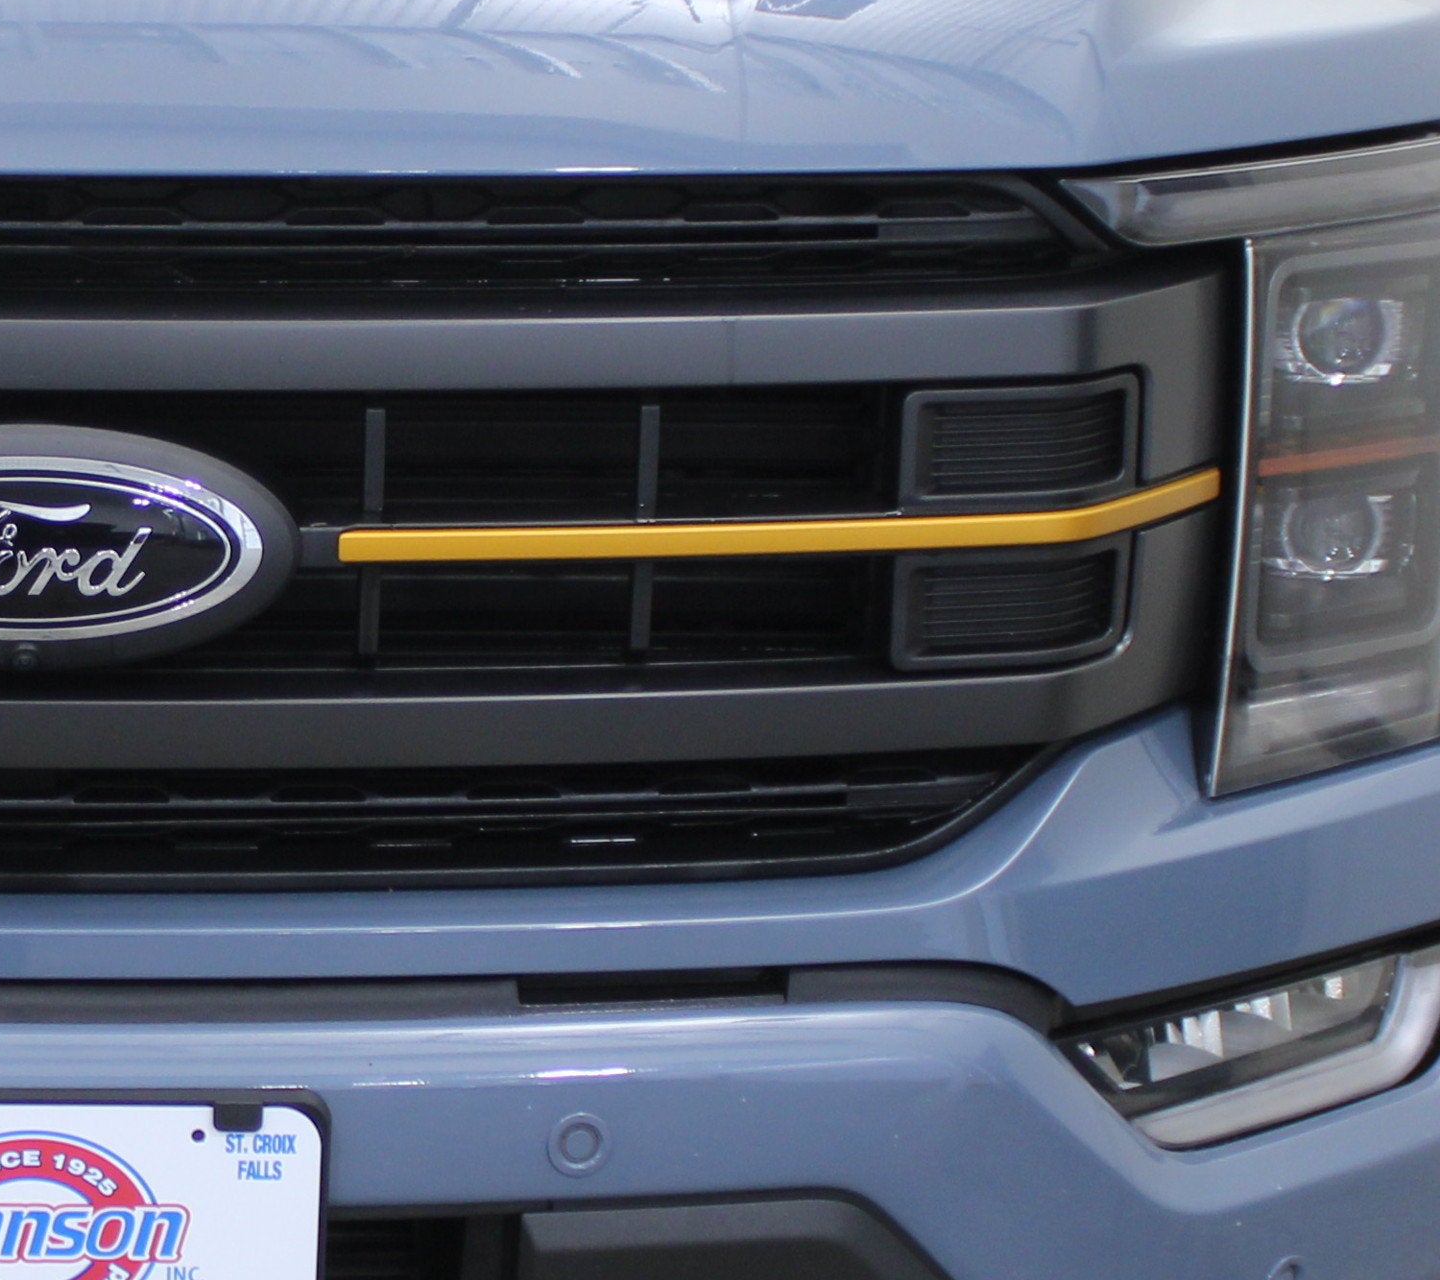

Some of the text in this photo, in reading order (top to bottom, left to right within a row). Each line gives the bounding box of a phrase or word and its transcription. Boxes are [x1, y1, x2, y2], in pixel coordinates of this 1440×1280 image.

[226, 1134, 296, 1154] ST. CROIX
[51, 1152, 118, 1198] 1925
[238, 1161, 281, 1180] FALLS
